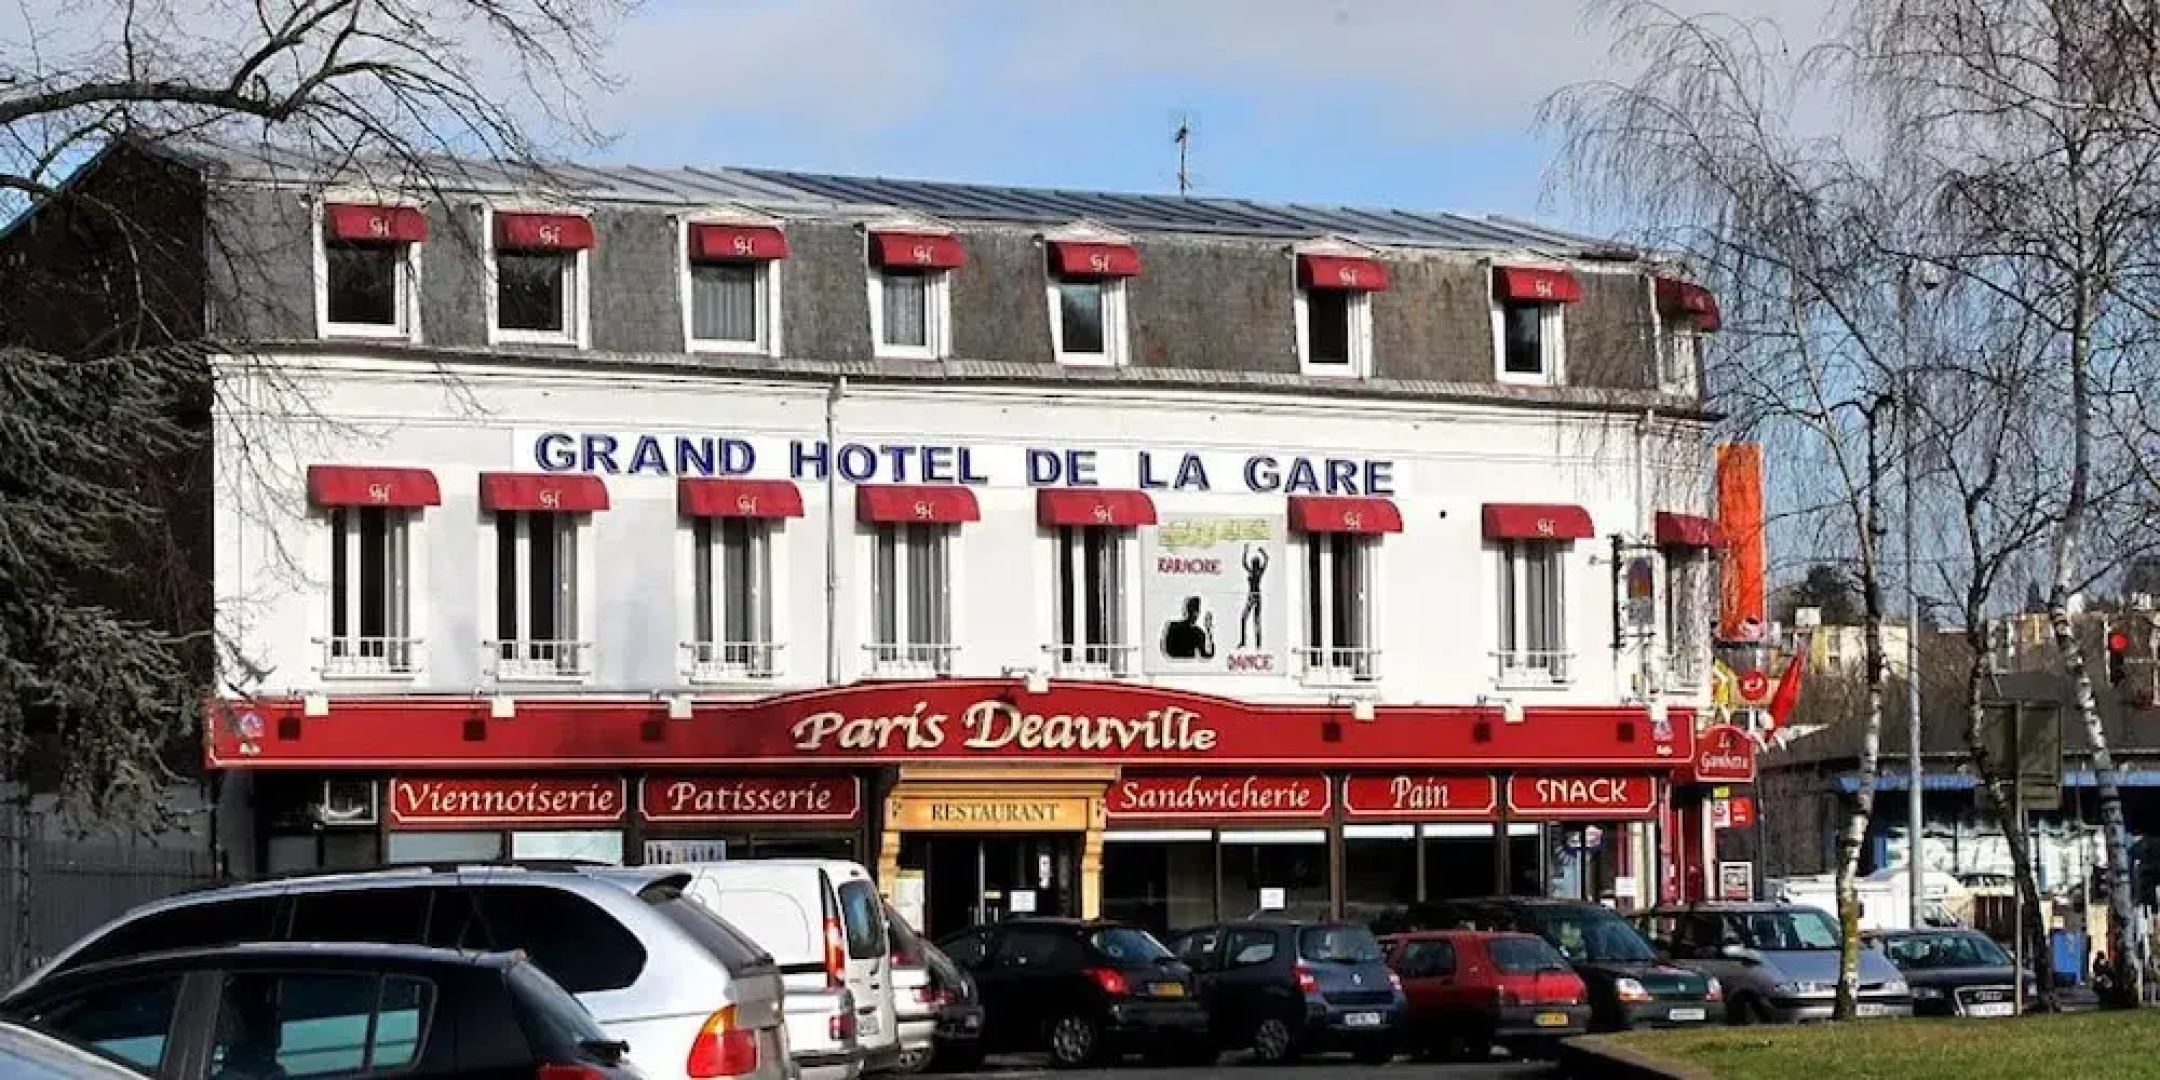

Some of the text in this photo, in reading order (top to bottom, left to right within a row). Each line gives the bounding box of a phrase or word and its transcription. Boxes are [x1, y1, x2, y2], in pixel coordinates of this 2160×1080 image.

[535, 432, 1397, 496] GRAND HOTEL DE LA GARE
[1157, 557, 1223, 576] KARAOKE
[1227, 654, 1275, 672] DANCE
[792, 701, 1219, 751] Paris Deauville
[399, 780, 615, 814] Viennoiserie
[666, 779, 833, 813] Patisserie
[1120, 775, 1311, 810] Sandwicherie
[1390, 776, 1450, 809] Pain
[1535, 779, 1628, 803] SNACK
[930, 802, 1060, 822] RESTAURANT
